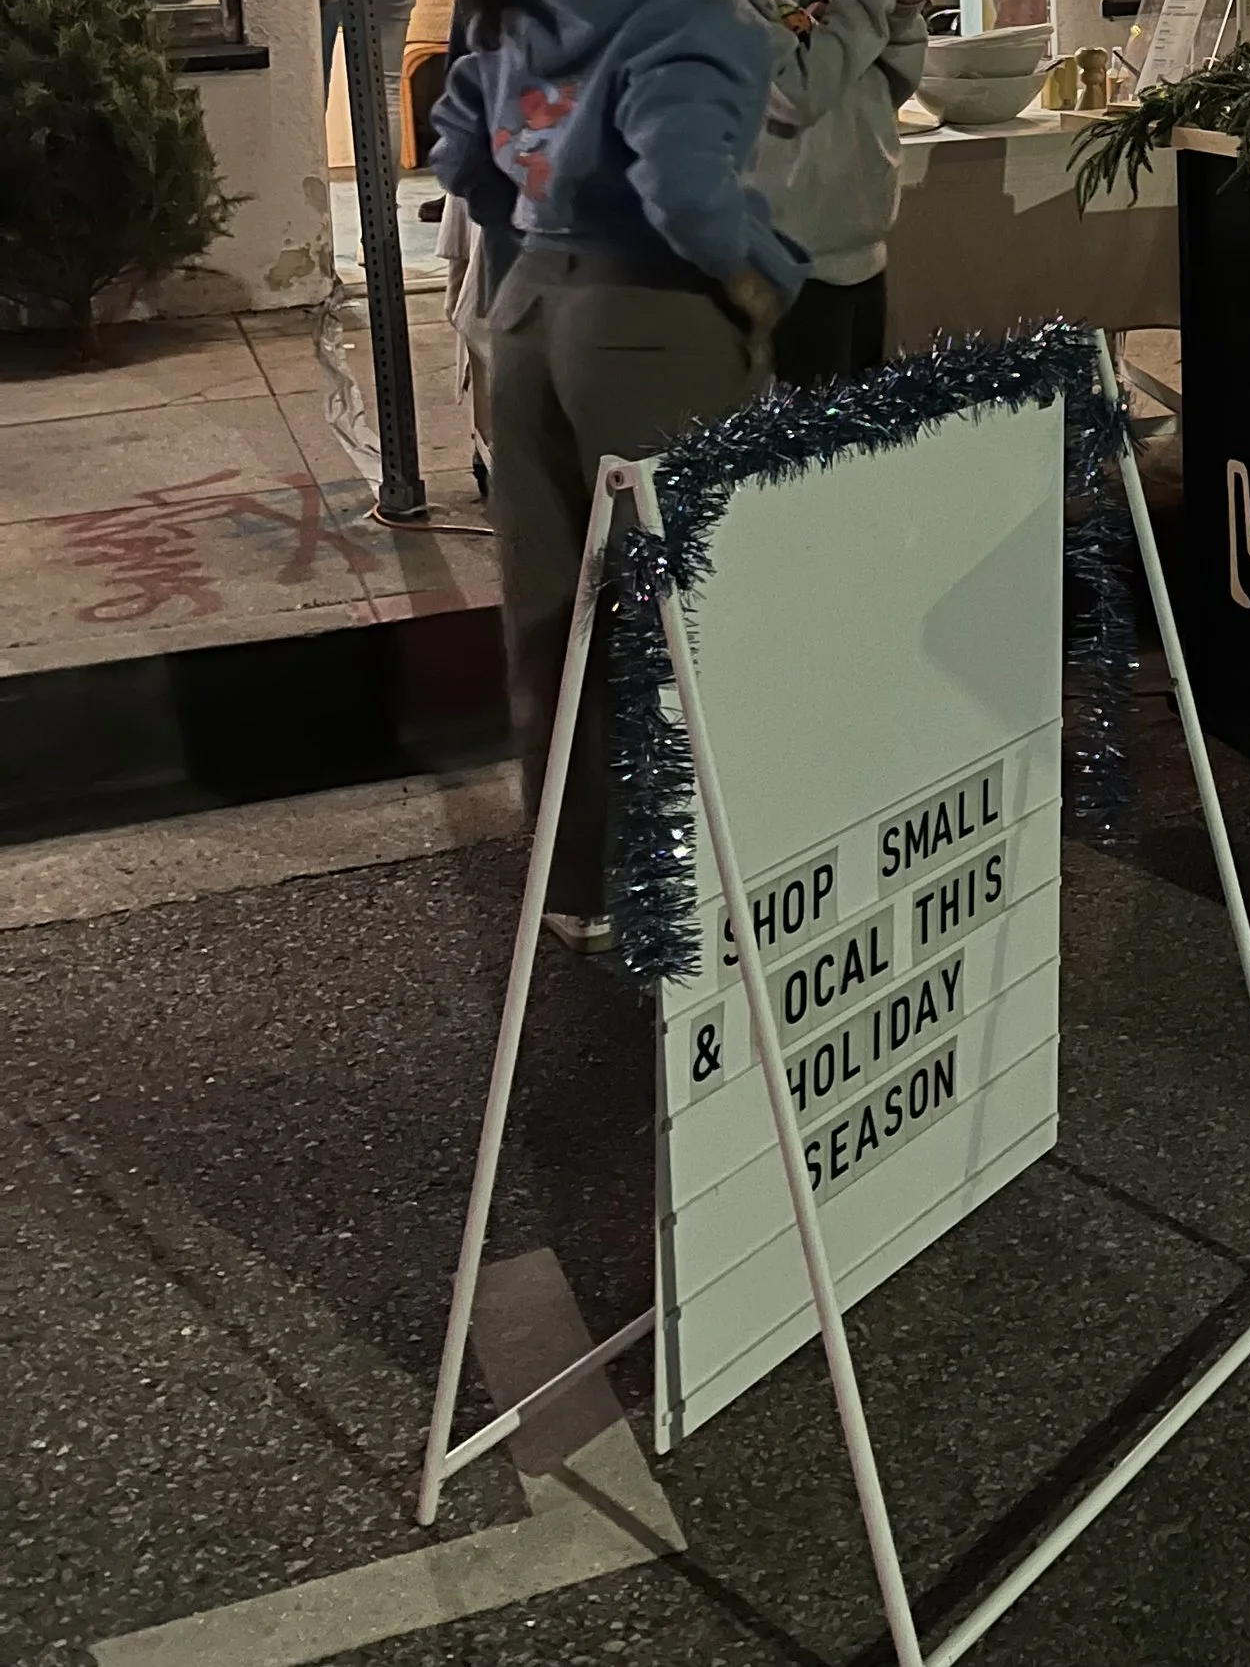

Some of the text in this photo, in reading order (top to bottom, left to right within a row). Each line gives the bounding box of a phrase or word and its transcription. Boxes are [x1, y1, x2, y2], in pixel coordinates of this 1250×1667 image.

[881, 777, 999, 878] SMALL
[693, 854, 1002, 1083] & OCAL THIS
[786, 959, 962, 1112] HOLIDAY
[804, 1049, 956, 1192] SEASON
